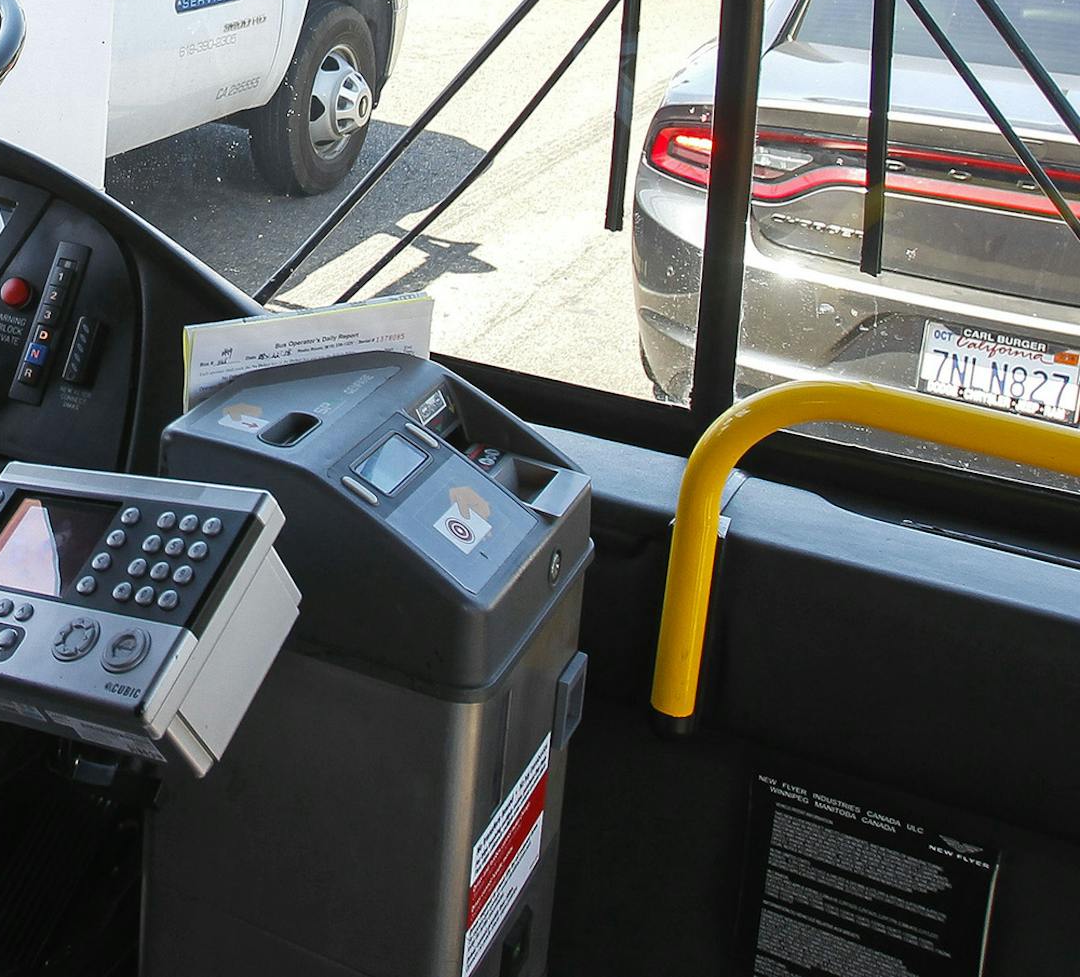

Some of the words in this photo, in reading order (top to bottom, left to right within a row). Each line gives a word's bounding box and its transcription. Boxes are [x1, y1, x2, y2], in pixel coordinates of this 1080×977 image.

[39, 330, 49, 340] D
[934, 329, 953, 342] OCT
[963, 328, 995, 342] CARL
[997, 334, 1048, 352] BURGER
[30, 349, 40, 359] N
[956, 336, 1055, 365] California
[23, 368, 33, 378] R
[933, 349, 1070, 408] 7NLN827
[111, 684, 142, 699] CUBIC
[758, 774, 777, 785] NEW
[782, 782, 808, 796] FLYER
[812, 792, 861, 814] INDUSTRIES
[866, 809, 902, 827] CANADA
[906, 823, 924, 835] ULC
[769, 786, 809, 805] WINNIPEG
[814, 800, 857, 821] MANITOBA
[861, 815, 897, 833] CANADA
[928, 844, 953, 857] NEW
[955, 853, 991, 869] FLYER
